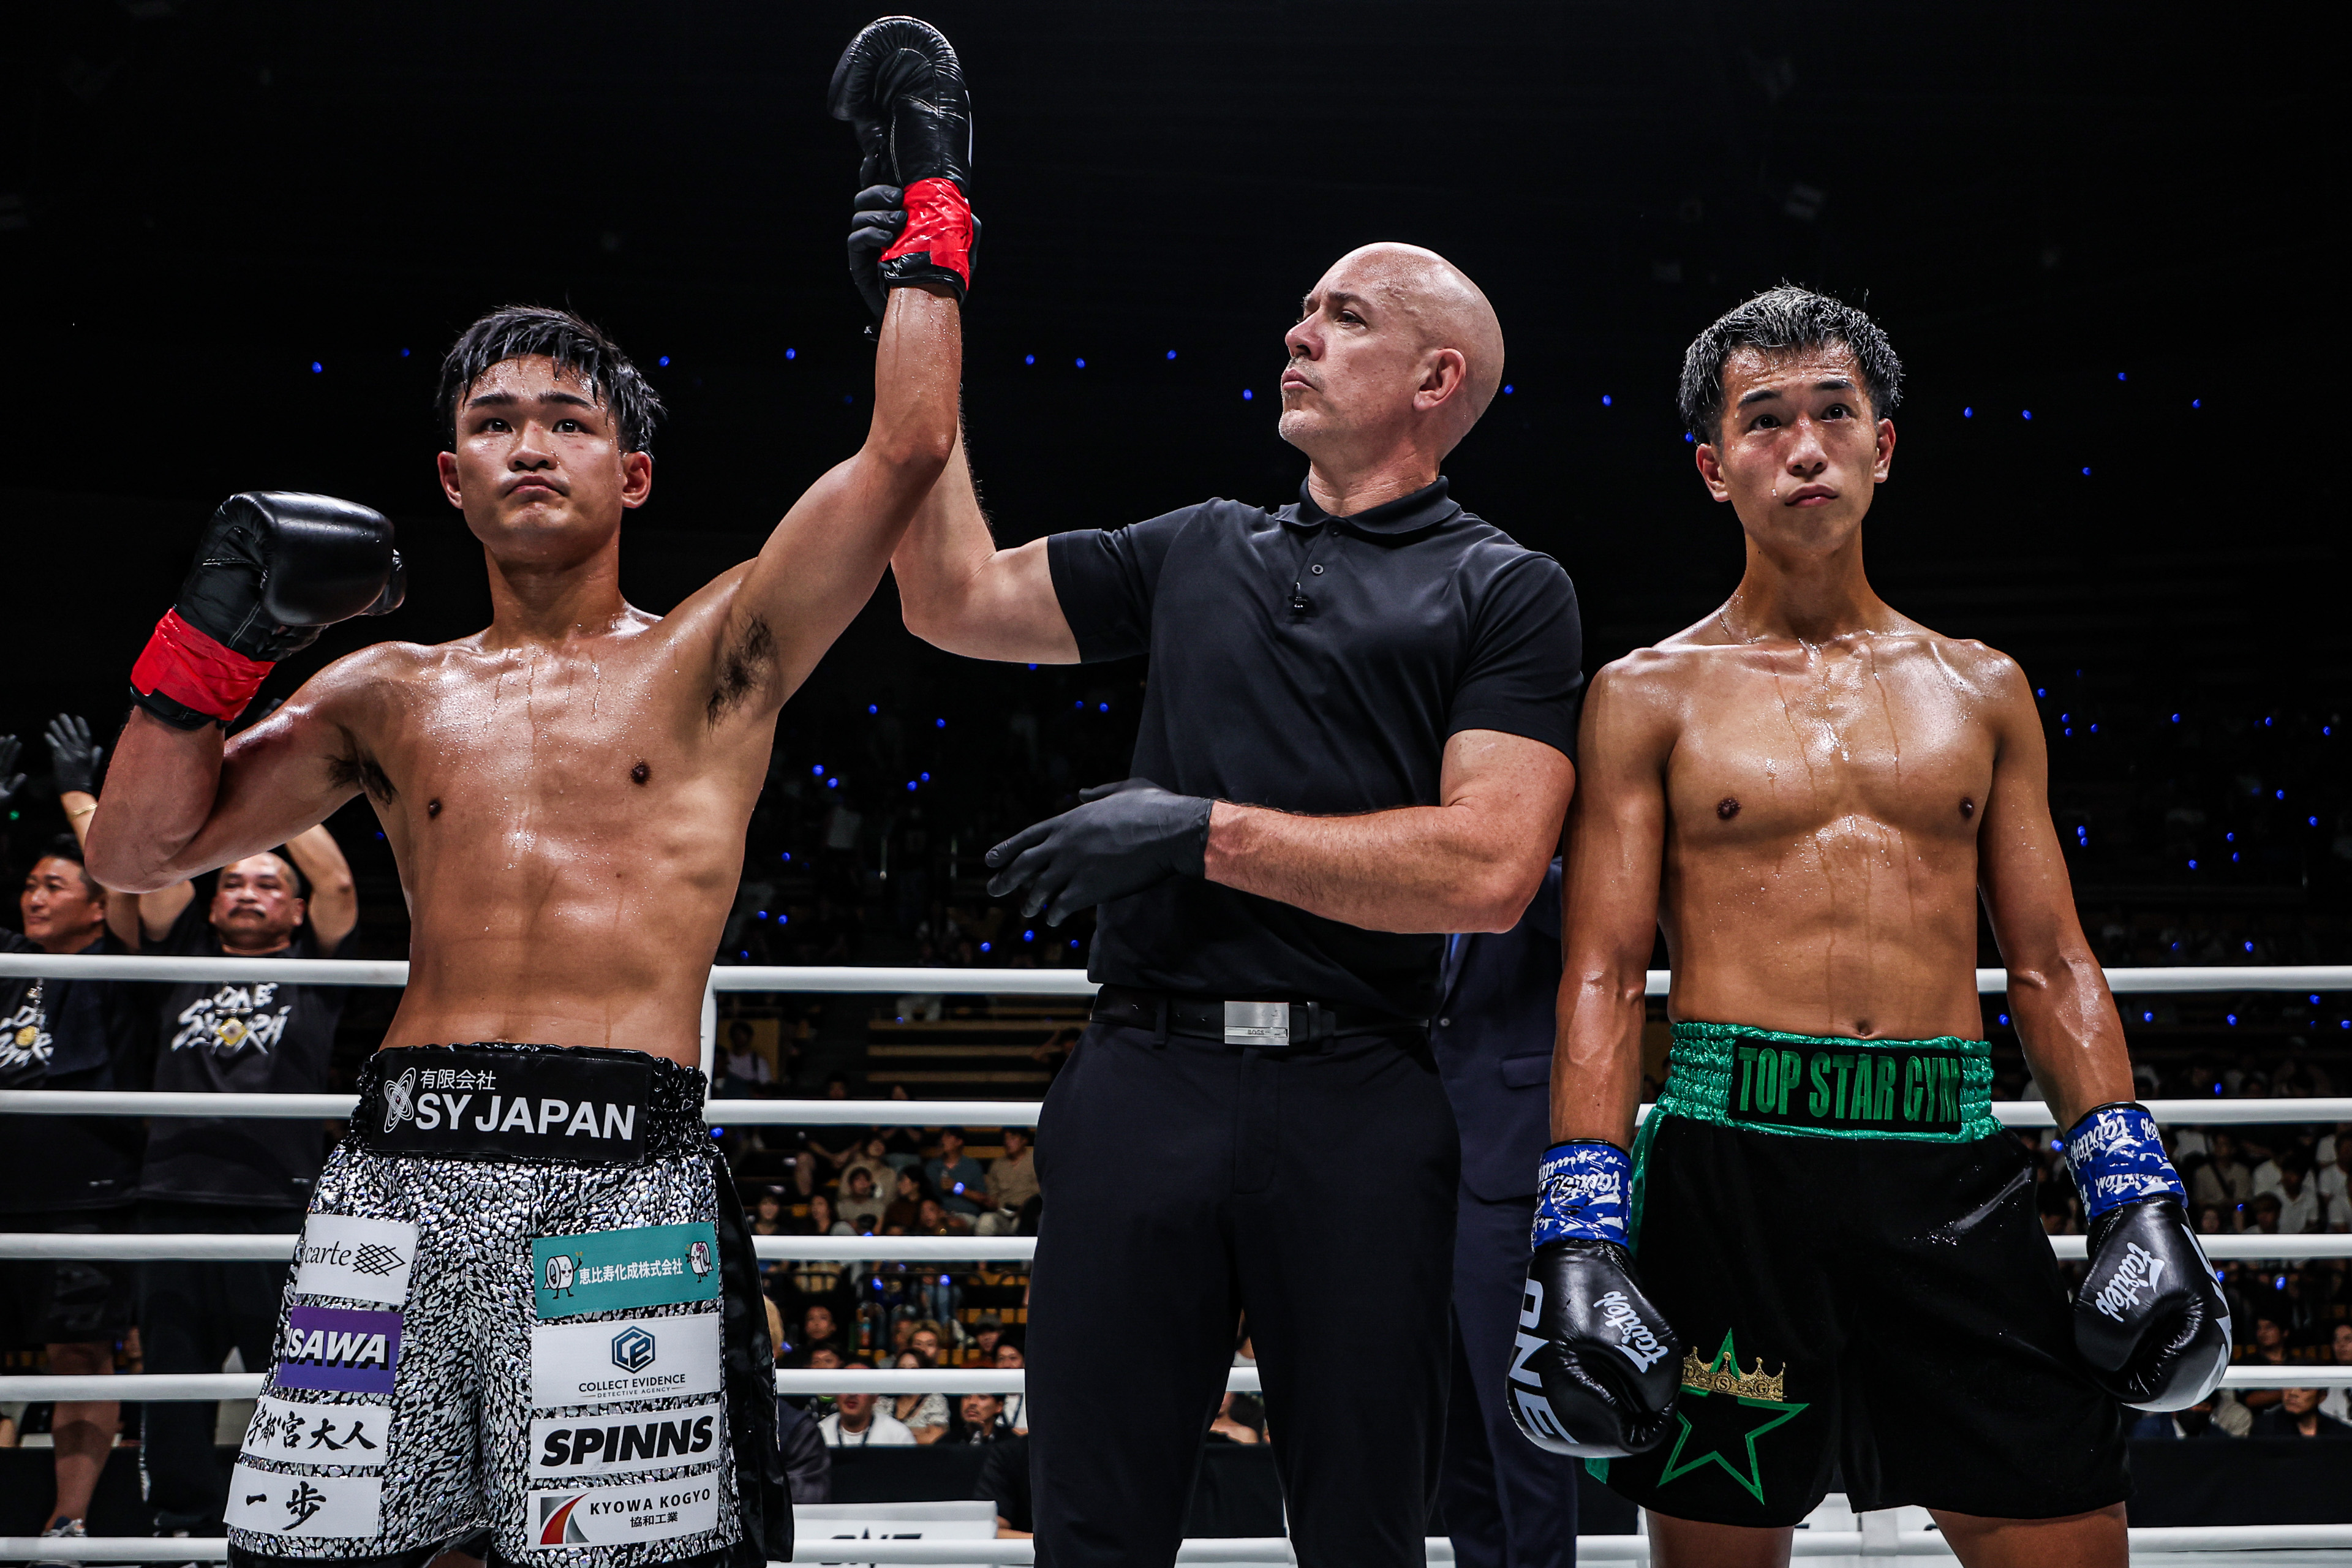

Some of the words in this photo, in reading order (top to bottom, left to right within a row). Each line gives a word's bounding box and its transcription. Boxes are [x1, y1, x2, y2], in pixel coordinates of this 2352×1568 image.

[420, 1068, 496, 1090] 有限会社
[1738, 1047, 1801, 1115] TOP
[1809, 1052, 1896, 1121] STAR
[1904, 1055, 1959, 1122] GYM
[415, 1093, 473, 1131] SY
[475, 1095, 635, 1140] JAPAN
[301, 1239, 352, 1266] carte
[579, 1257, 684, 1285] 恵比寿化成株式会社
[1509, 1278, 1580, 1444] ONE
[579, 1379, 629, 1392] COLLECT
[632, 1374, 685, 1388] EVIDENCE
[597, 1389, 638, 1398] DETECTIVE
[540, 1415, 714, 1467] SPINNS
[246, 1480, 327, 1531] 一歩
[590, 1498, 653, 1515] KYOWA
[660, 1488, 710, 1509] KOGYO
[630, 1511, 679, 1528] 協和工業
